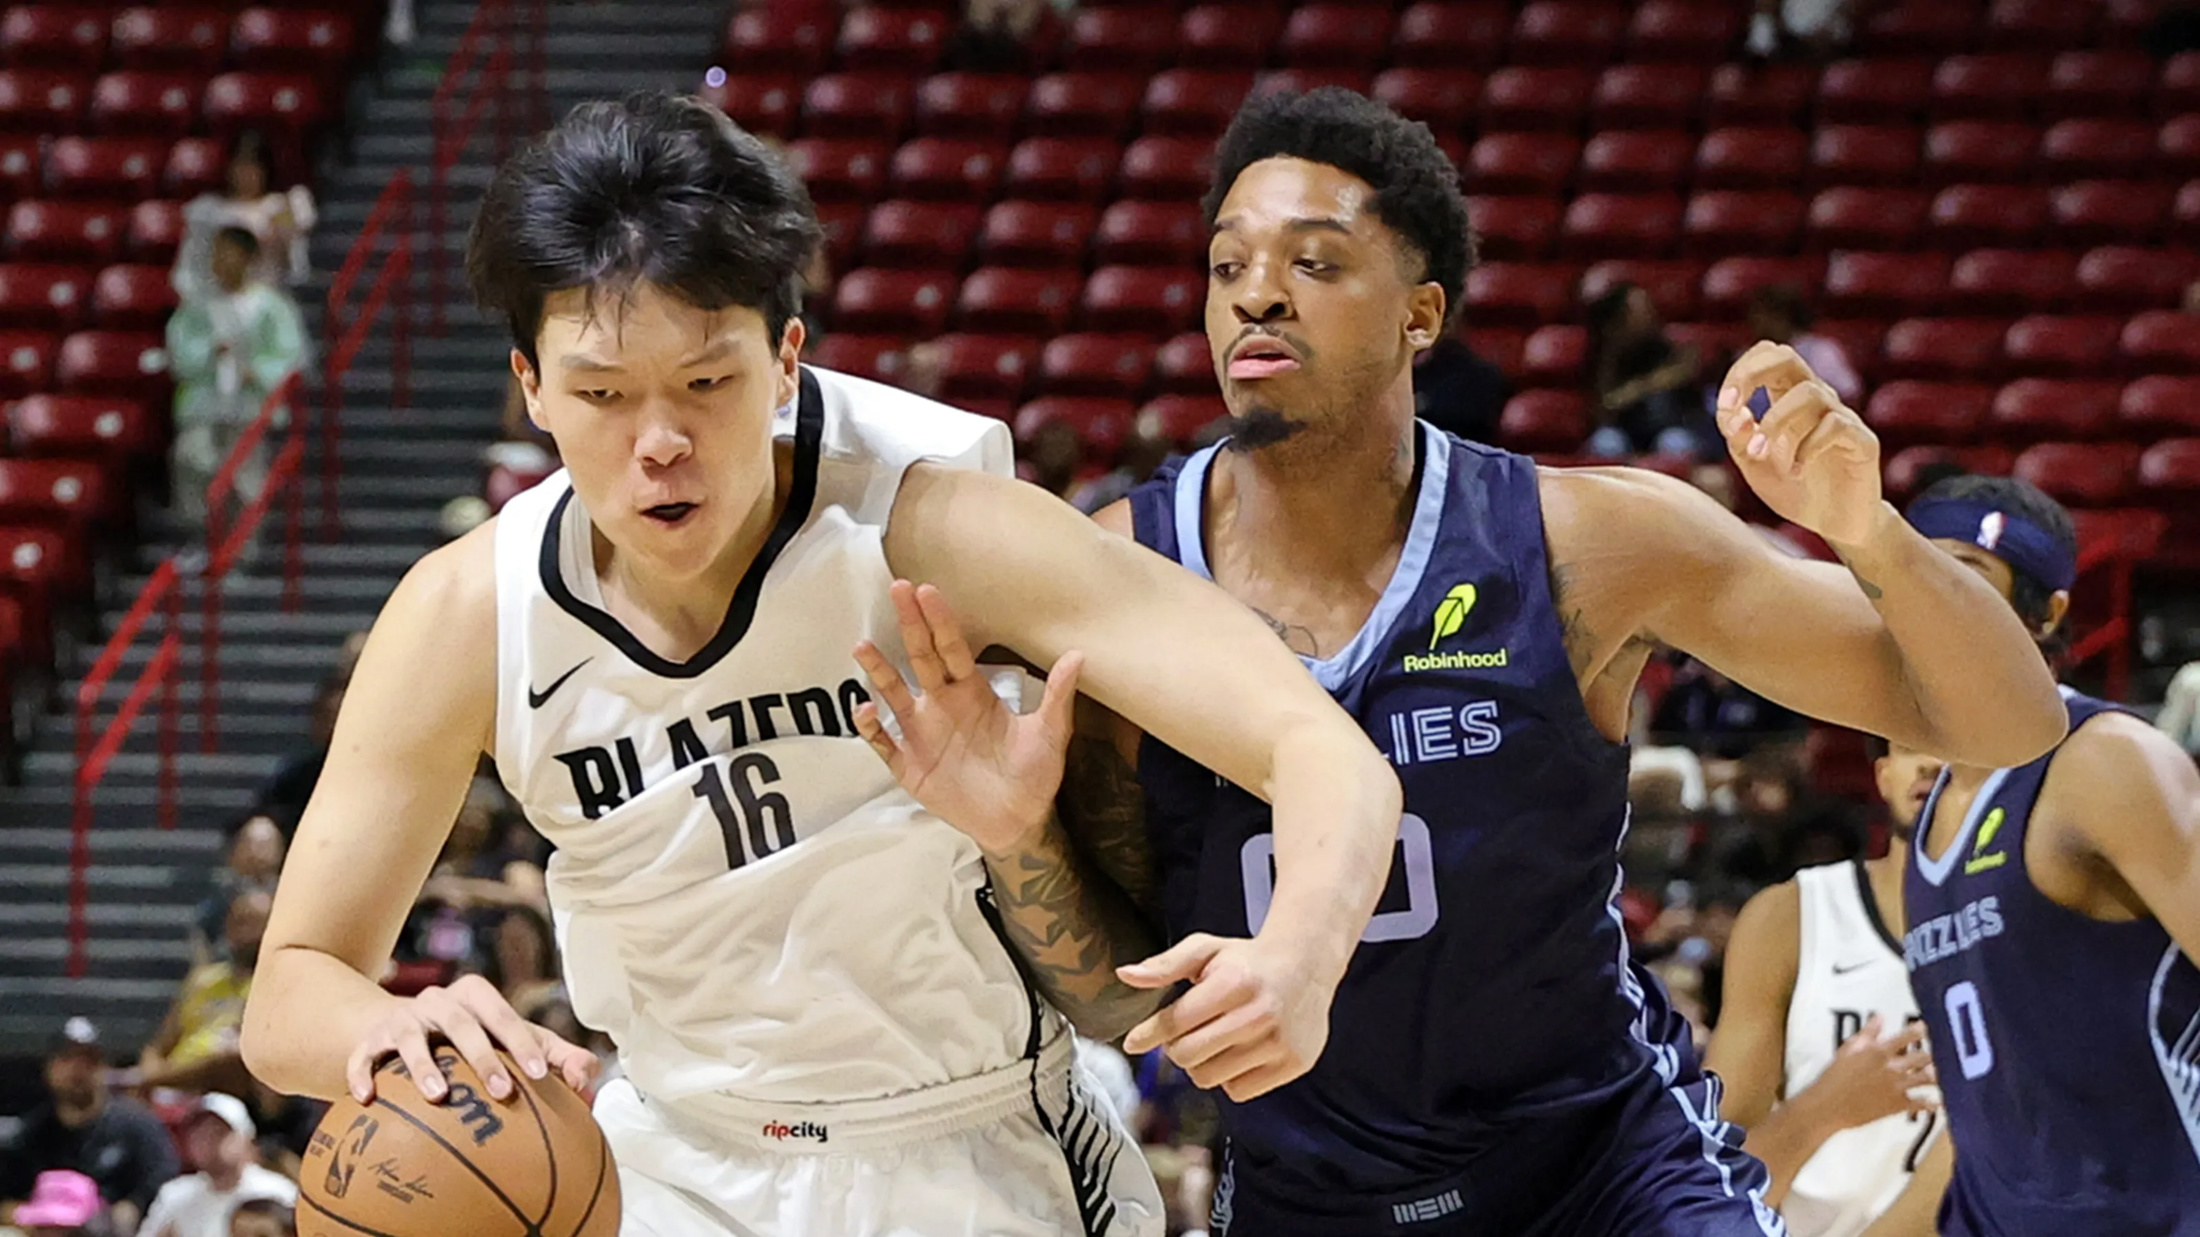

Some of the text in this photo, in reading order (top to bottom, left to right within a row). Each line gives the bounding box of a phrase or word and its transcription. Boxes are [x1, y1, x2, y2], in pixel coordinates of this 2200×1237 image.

[1404, 649, 1507, 672] Robinhood
[691, 752, 797, 870] 16
[1945, 981, 1993, 1080] 0
[763, 1120, 828, 1142] ripcity
